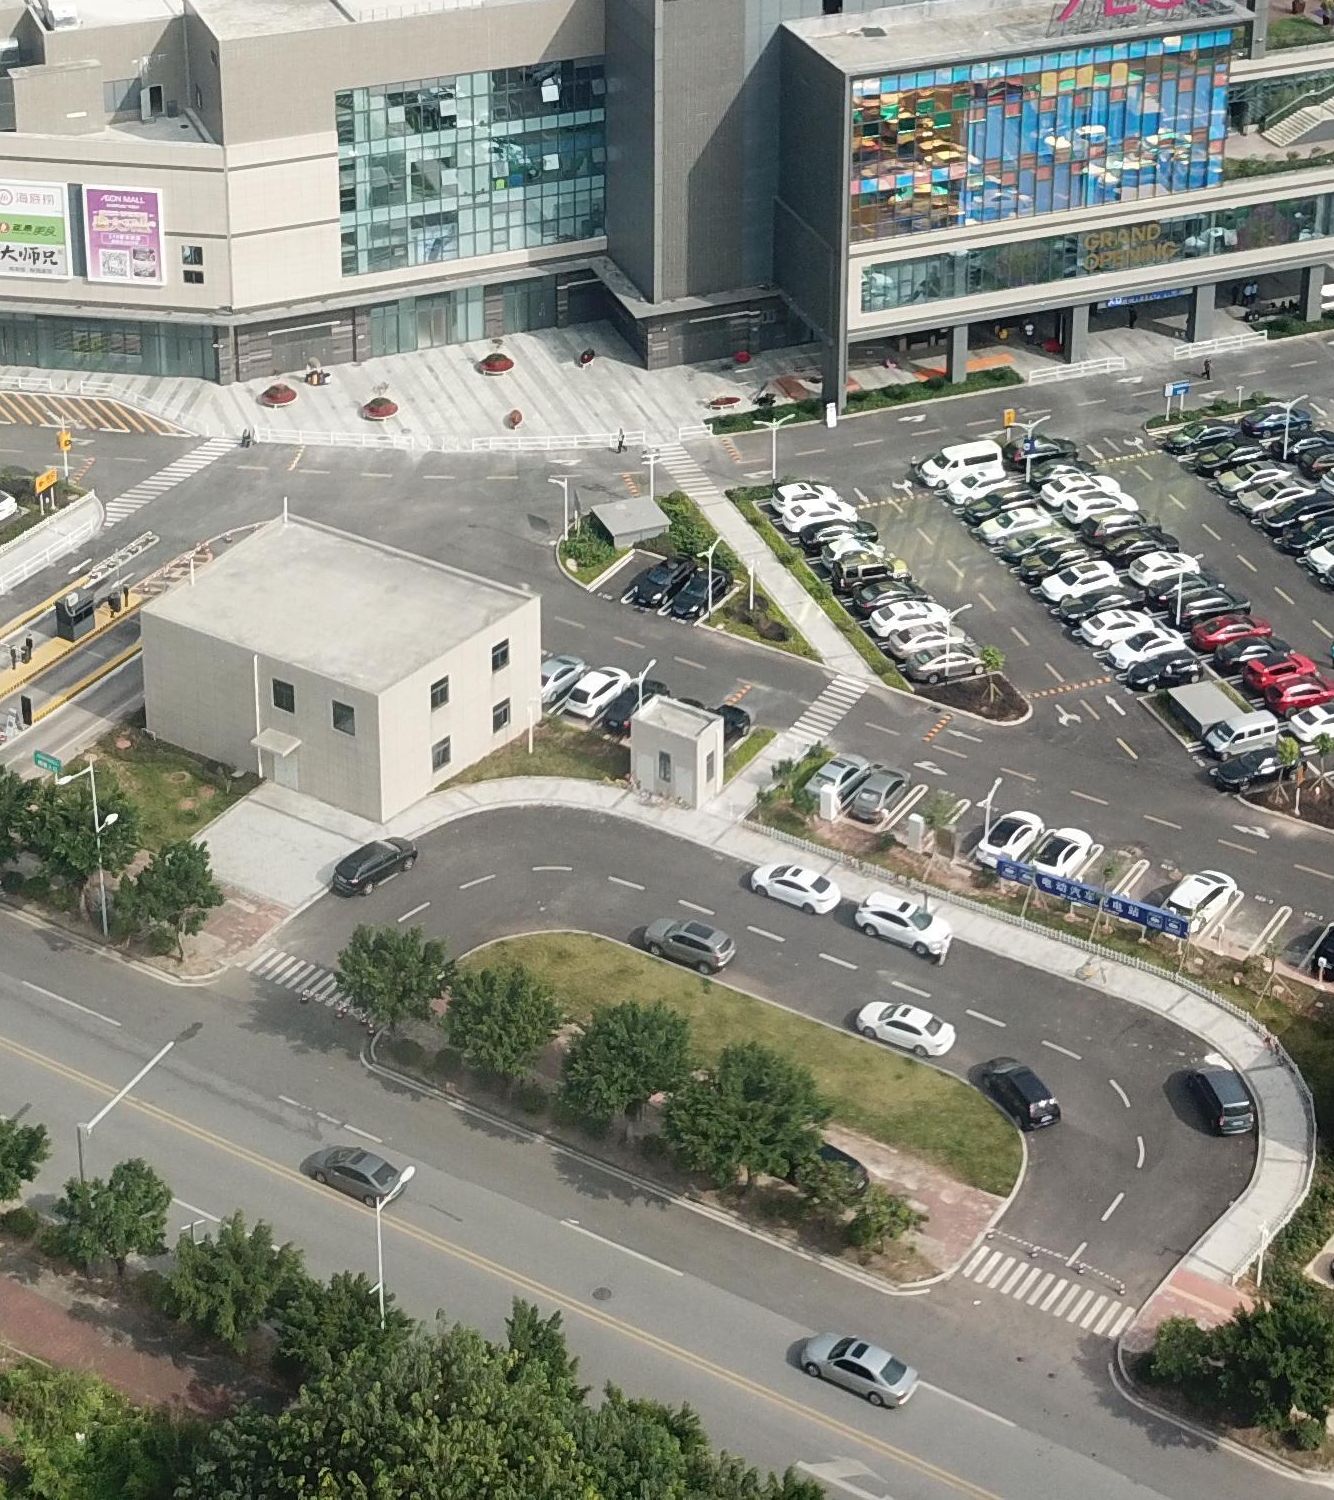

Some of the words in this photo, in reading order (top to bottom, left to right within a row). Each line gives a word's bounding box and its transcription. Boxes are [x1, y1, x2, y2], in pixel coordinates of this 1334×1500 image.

[122, 195, 146, 205] MALL
[1083, 223, 1162, 251] GRAND
[0, 244, 60, 267] 大师兄
[1083, 241, 1181, 272] OPENING
